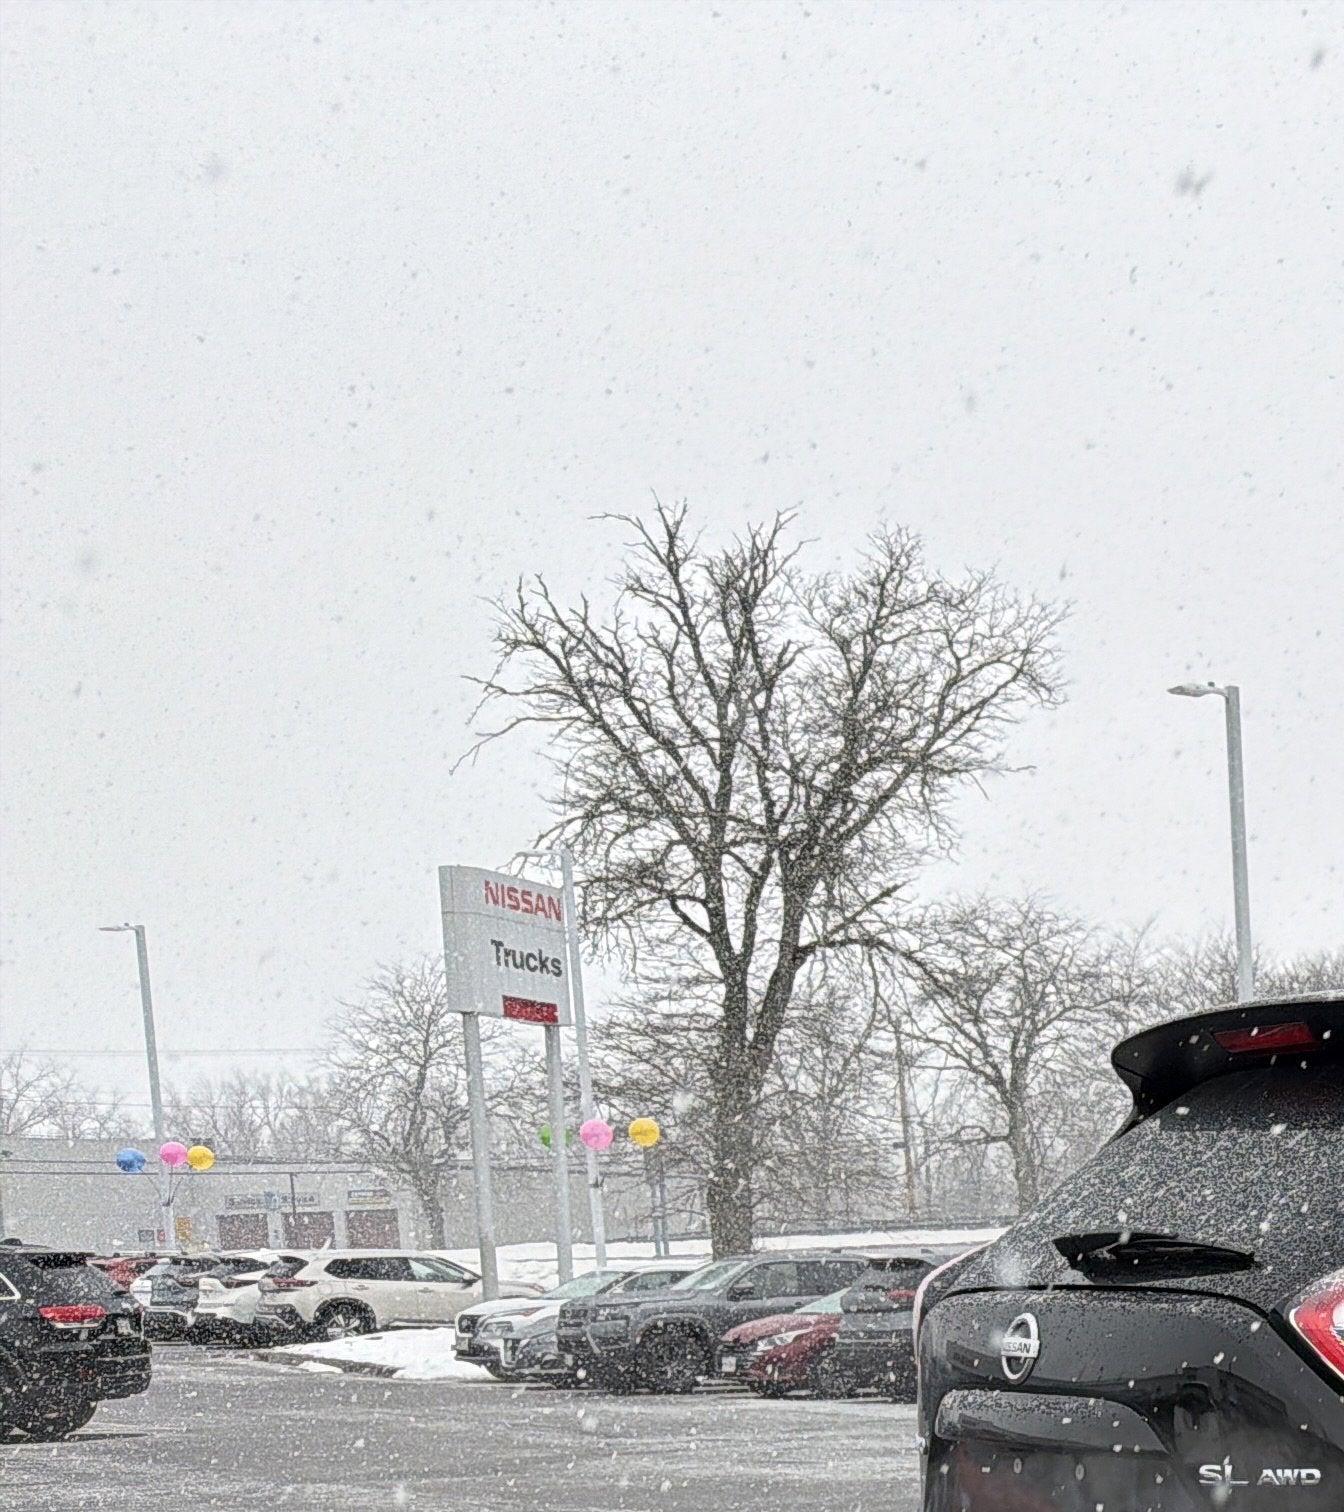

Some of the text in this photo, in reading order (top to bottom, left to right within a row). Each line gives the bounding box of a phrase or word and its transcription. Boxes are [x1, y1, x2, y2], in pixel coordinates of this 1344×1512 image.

[484, 879, 562, 922] NISSAN
[490, 938, 563, 978] Trucks
[1002, 1340, 1031, 1354] ISSAN
[1198, 1464, 1321, 1486] SL AWD
